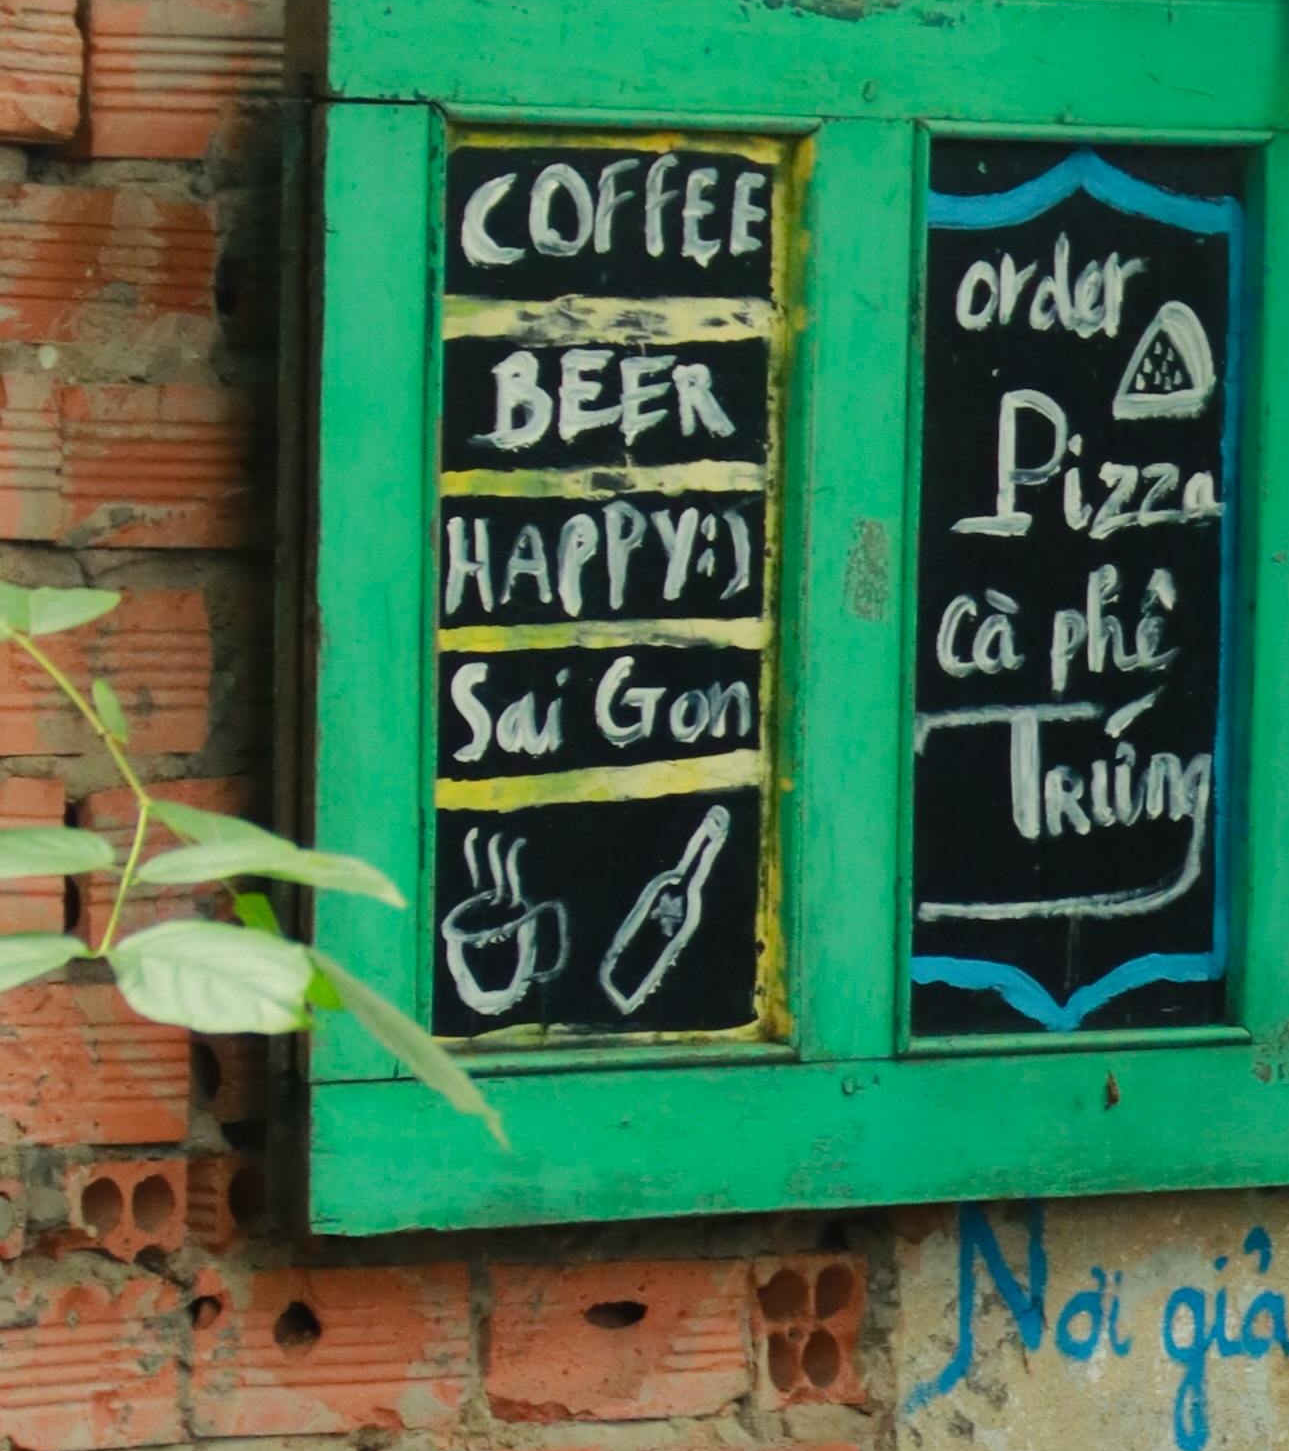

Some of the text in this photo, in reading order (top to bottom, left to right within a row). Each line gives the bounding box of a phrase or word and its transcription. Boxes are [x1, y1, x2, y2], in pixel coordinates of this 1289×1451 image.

[461, 152, 767, 268] COFFEE
[956, 231, 1150, 338] order
[469, 349, 737, 452] BEER
[950, 388, 1227, 540] Pizza
[451, 655, 751, 763] Sai Gon
